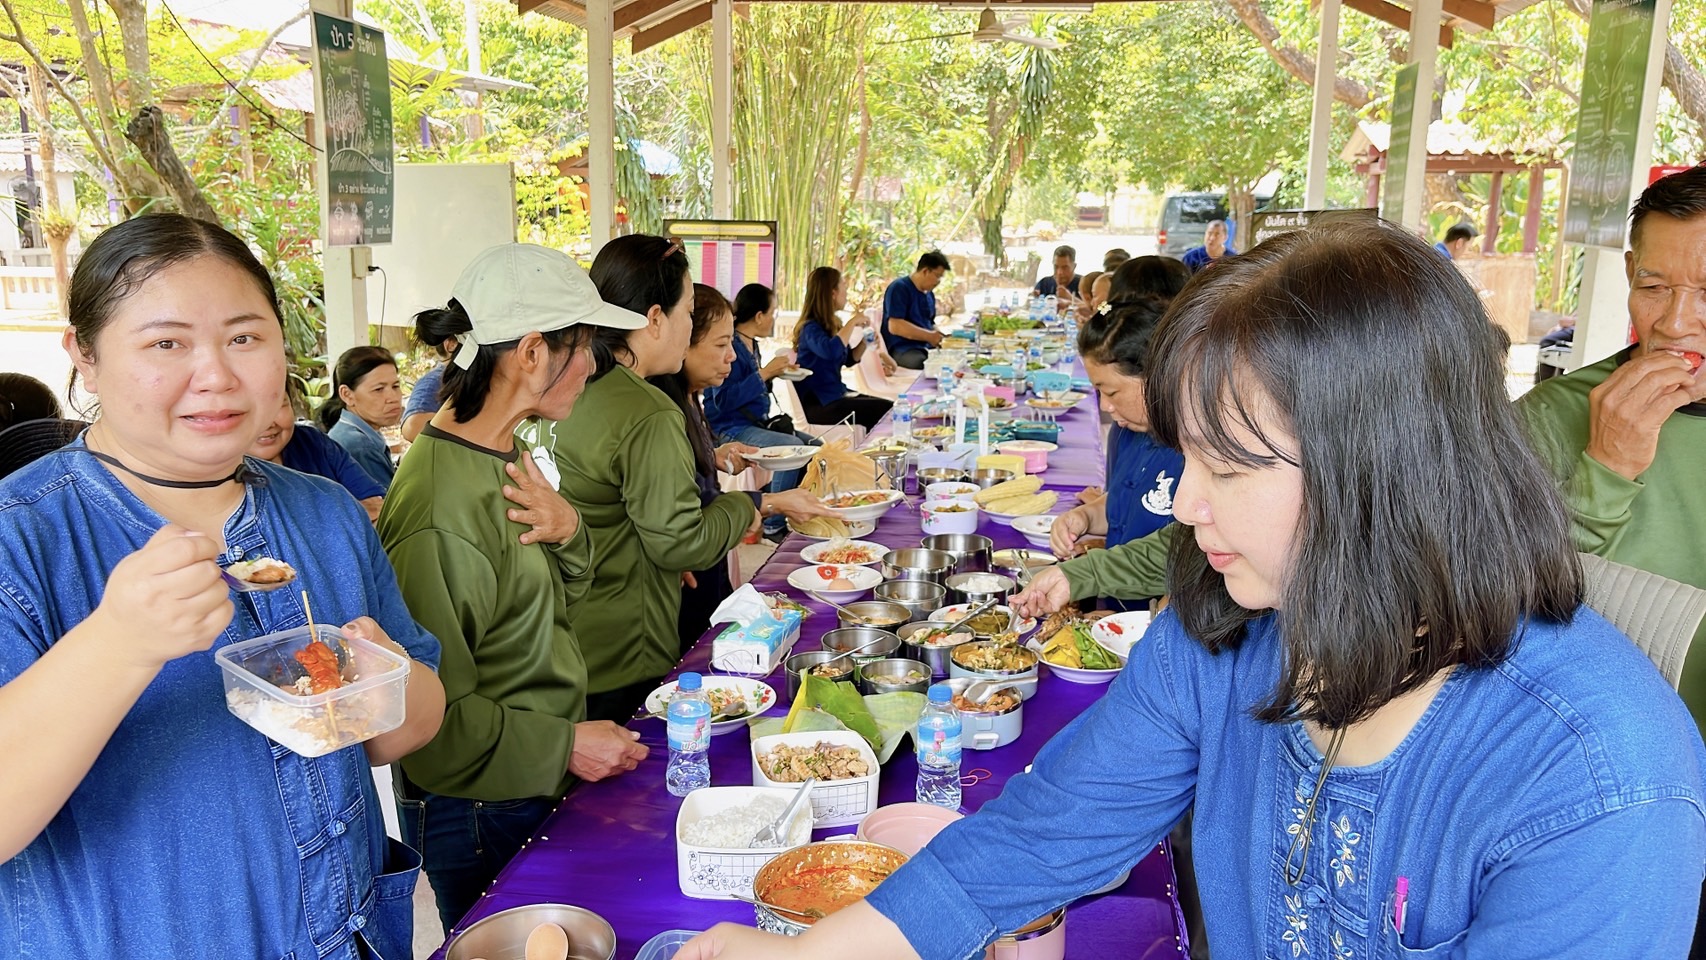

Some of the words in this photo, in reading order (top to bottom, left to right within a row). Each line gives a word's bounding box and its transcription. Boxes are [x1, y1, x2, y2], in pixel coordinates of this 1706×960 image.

[330, 24, 345, 48] ป่า
[348, 33, 354, 50] 5
[356, 33, 377, 56] ระดับ
[1265, 214, 1287, 227] บันได
[1296, 212, 1308, 226] ขั้น
